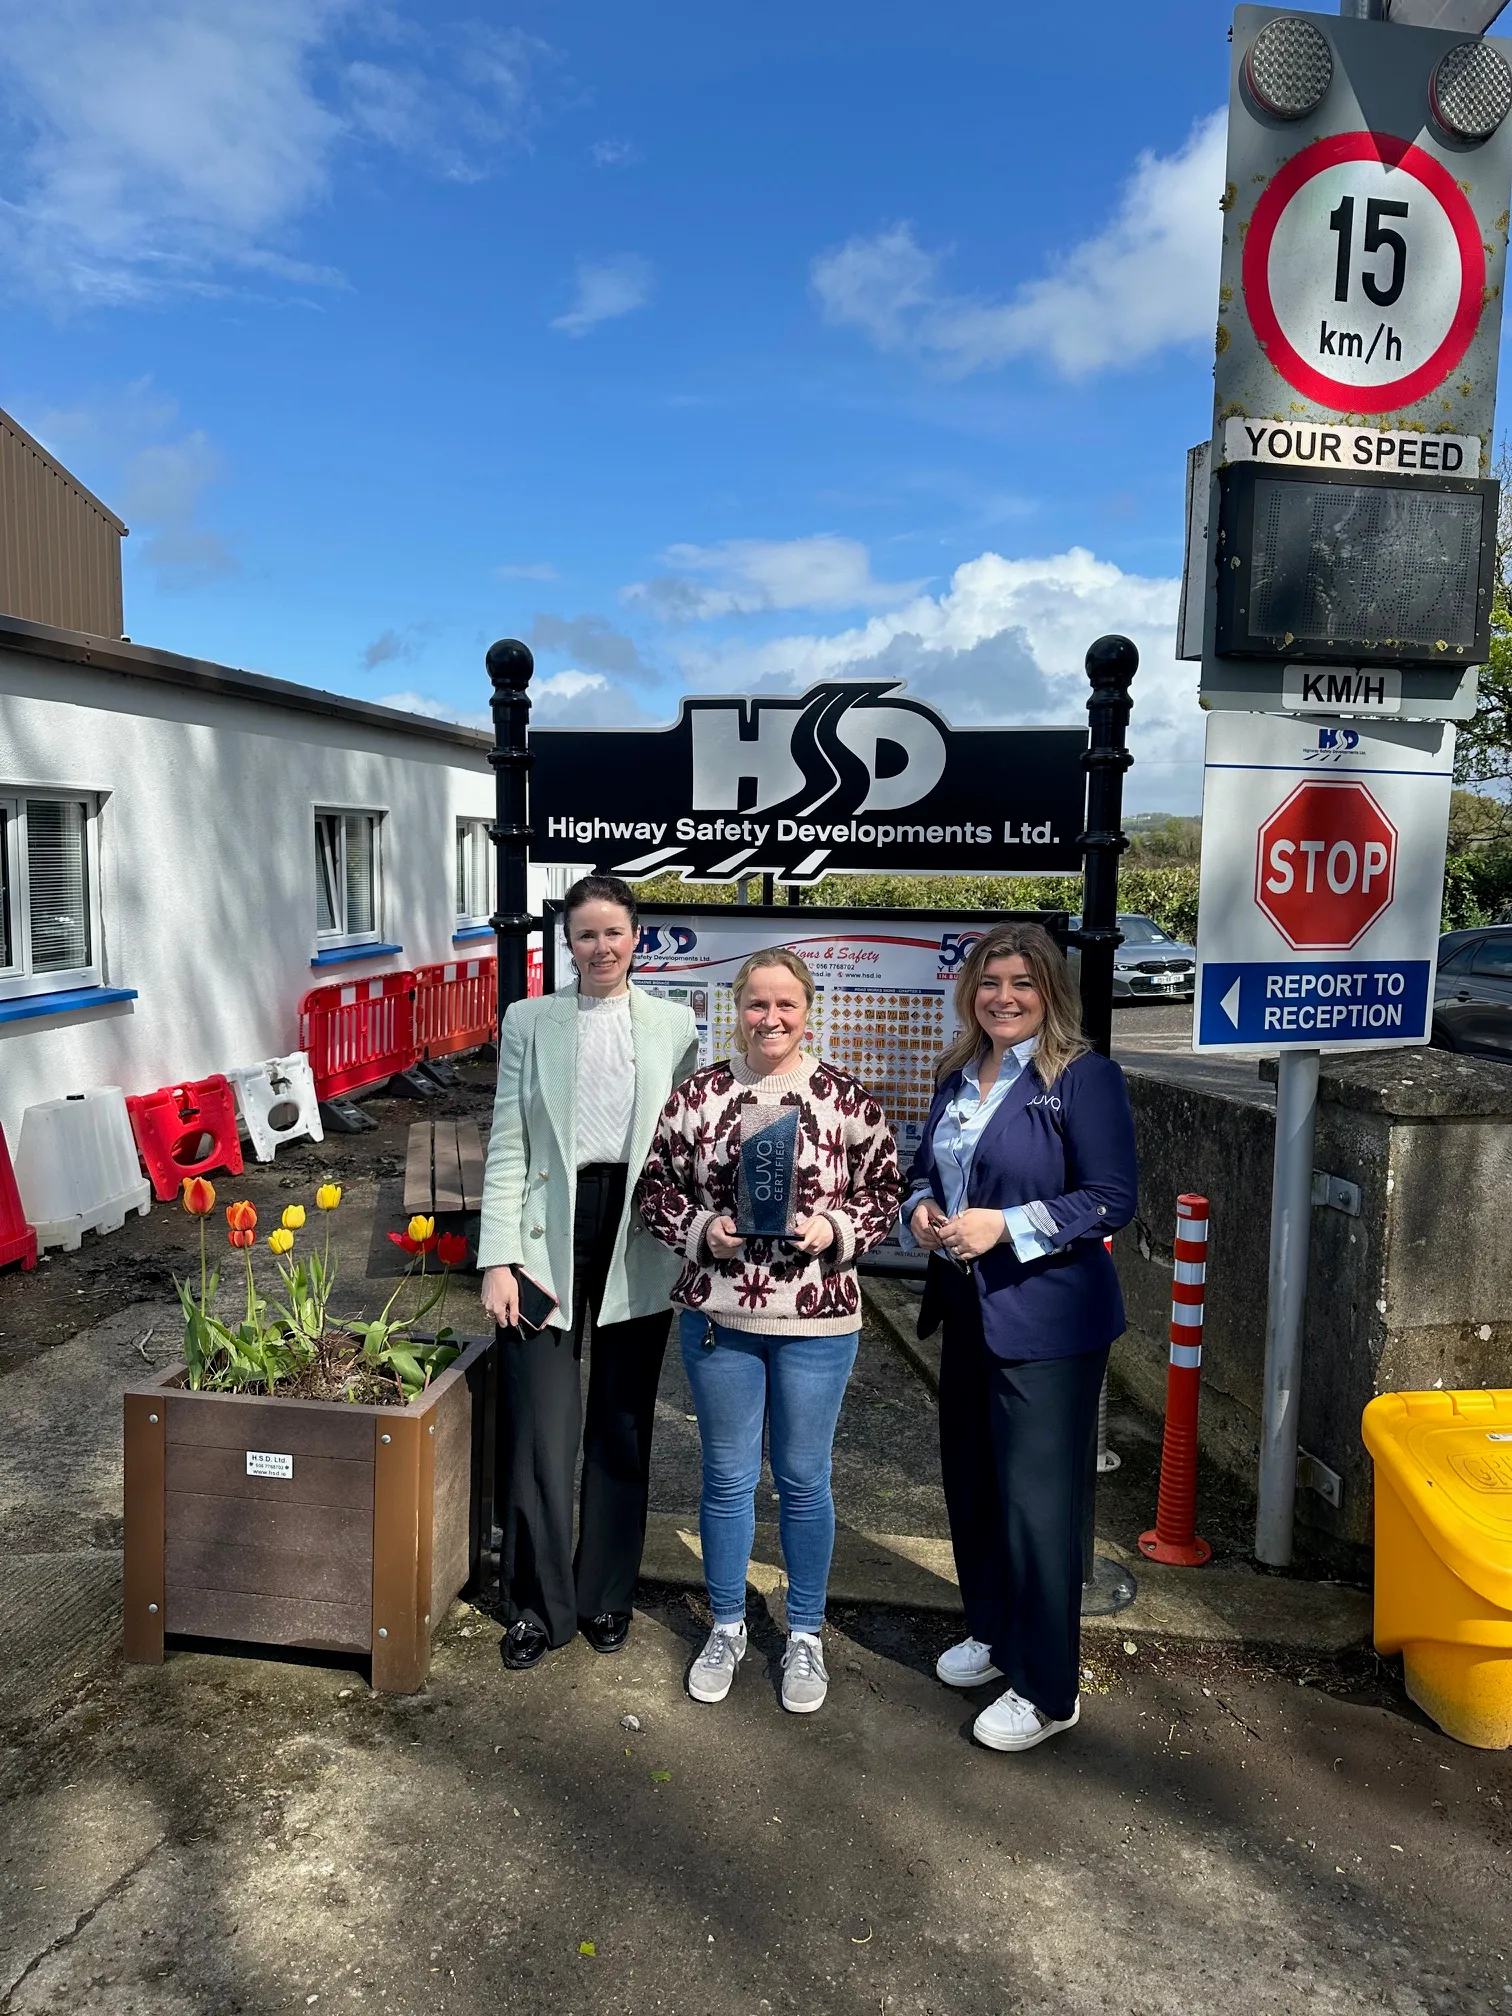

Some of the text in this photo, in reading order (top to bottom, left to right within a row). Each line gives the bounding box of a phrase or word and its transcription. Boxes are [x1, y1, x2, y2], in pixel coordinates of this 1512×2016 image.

[1330, 195, 1409, 307] 15
[1319, 320, 1402, 365] km/h
[1244, 426, 1464, 473] YOUR SPEED
[1302, 673, 1386, 705] KM/H
[547, 816, 1060, 848] Highway Safety Developments Ltd.
[1265, 838, 1388, 896] STOP
[823, 946, 834, 959] &
[837, 946, 880, 963] Safety
[1265, 973, 1405, 998] REPORT TO
[1264, 1003, 1403, 1031] RECEPTION
[774, 1140, 785, 1202] CERTIFIED
[894, 1251, 930, 1259] INSTALLATIO
